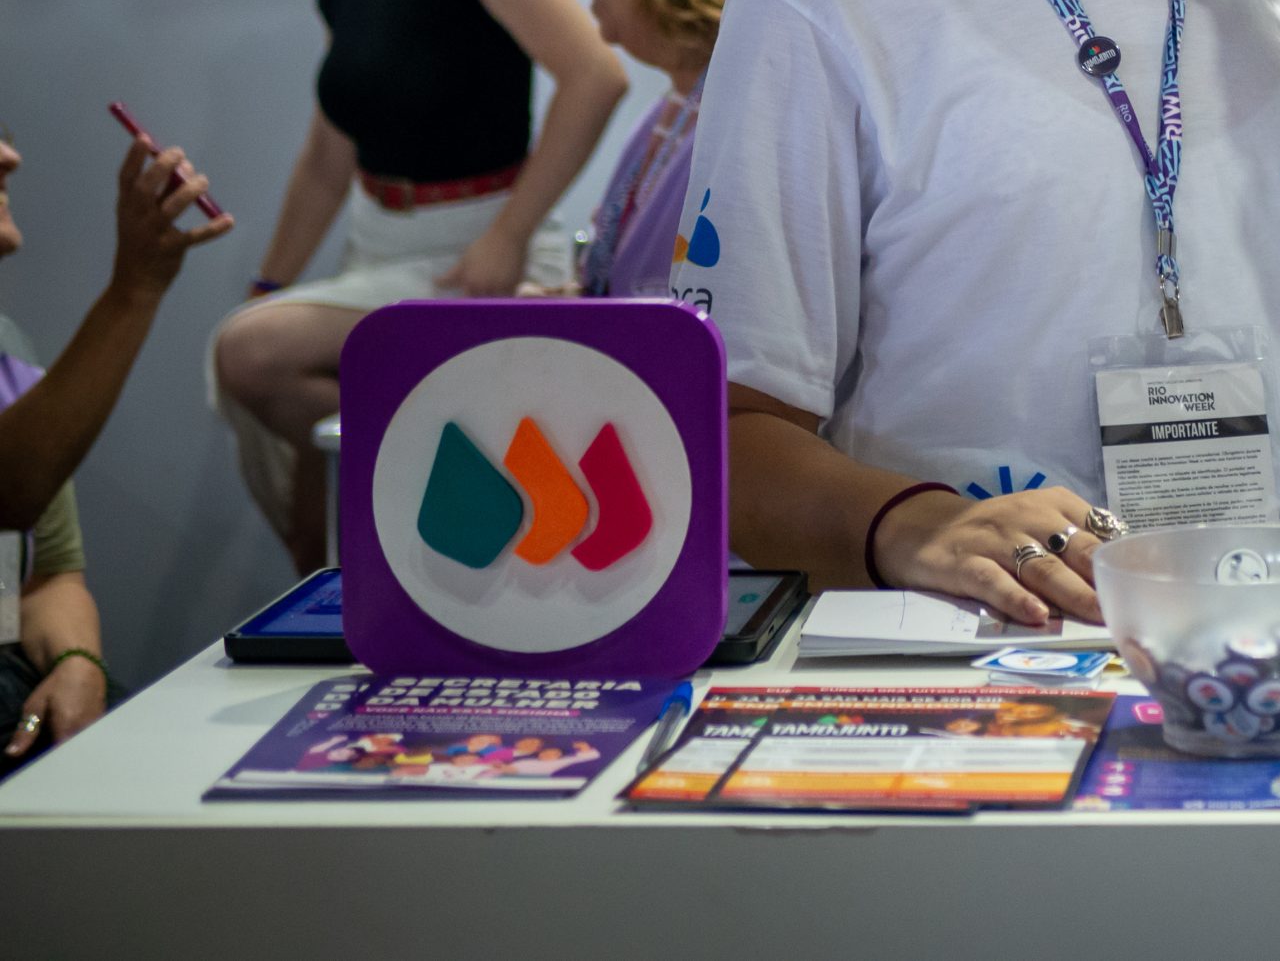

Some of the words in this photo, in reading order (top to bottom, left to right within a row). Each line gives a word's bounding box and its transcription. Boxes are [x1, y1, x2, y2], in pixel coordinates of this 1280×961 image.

[1147, 385, 1167, 397] RIO
[1148, 391, 1215, 406] INNOVATION
[1184, 401, 1216, 413] WEEK
[1151, 420, 1220, 440] IMPORTANTE
[390, 677, 641, 691] SECRETARIA
[378, 687, 434, 697] DE
[439, 688, 600, 699] ESTADO
[365, 697, 419, 706] DA
[428, 697, 600, 709] MULHER
[771, 723, 909, 736] TAMOJUNTO
